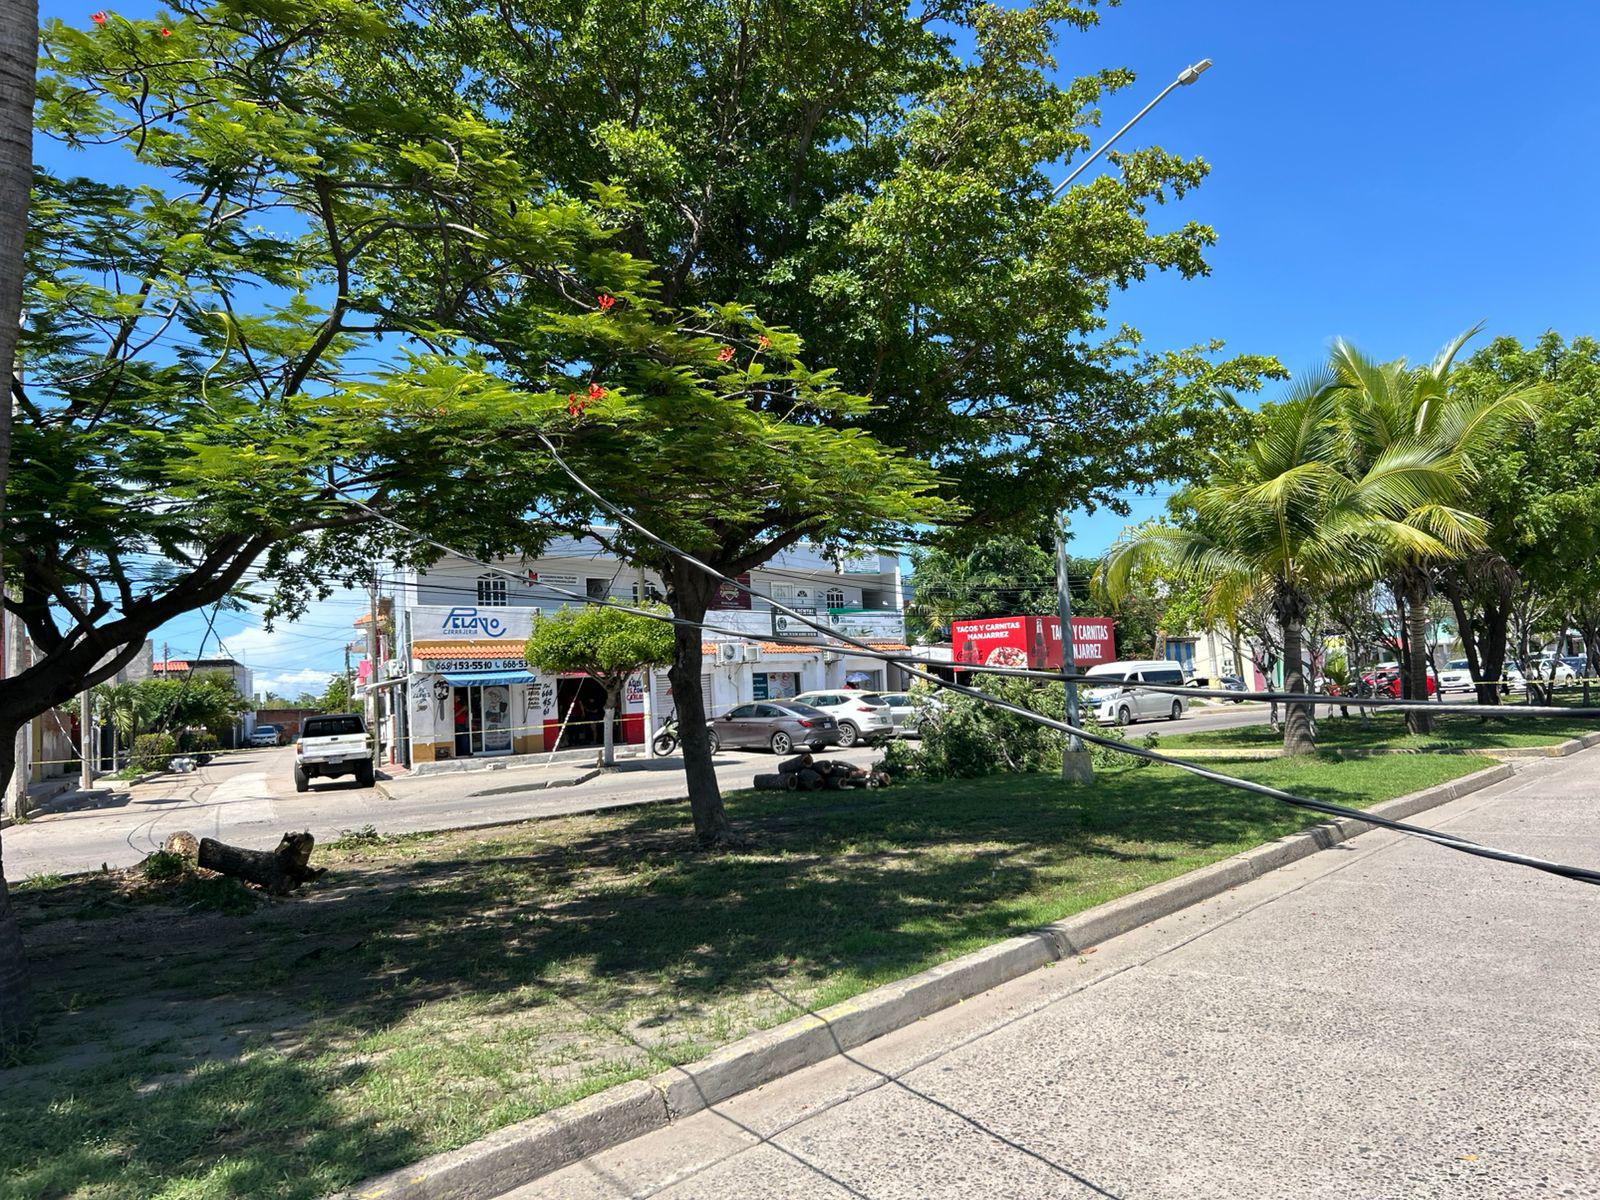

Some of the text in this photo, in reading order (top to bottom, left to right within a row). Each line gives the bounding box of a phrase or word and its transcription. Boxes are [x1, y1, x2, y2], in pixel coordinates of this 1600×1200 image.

[956, 624, 977, 632] TACOS
[985, 621, 1021, 630] CARNITAS
[1078, 624, 1109, 640] CARNITAS
[967, 631, 1009, 640] MANJARREZ
[1072, 643, 1102, 659] NJARREZ
